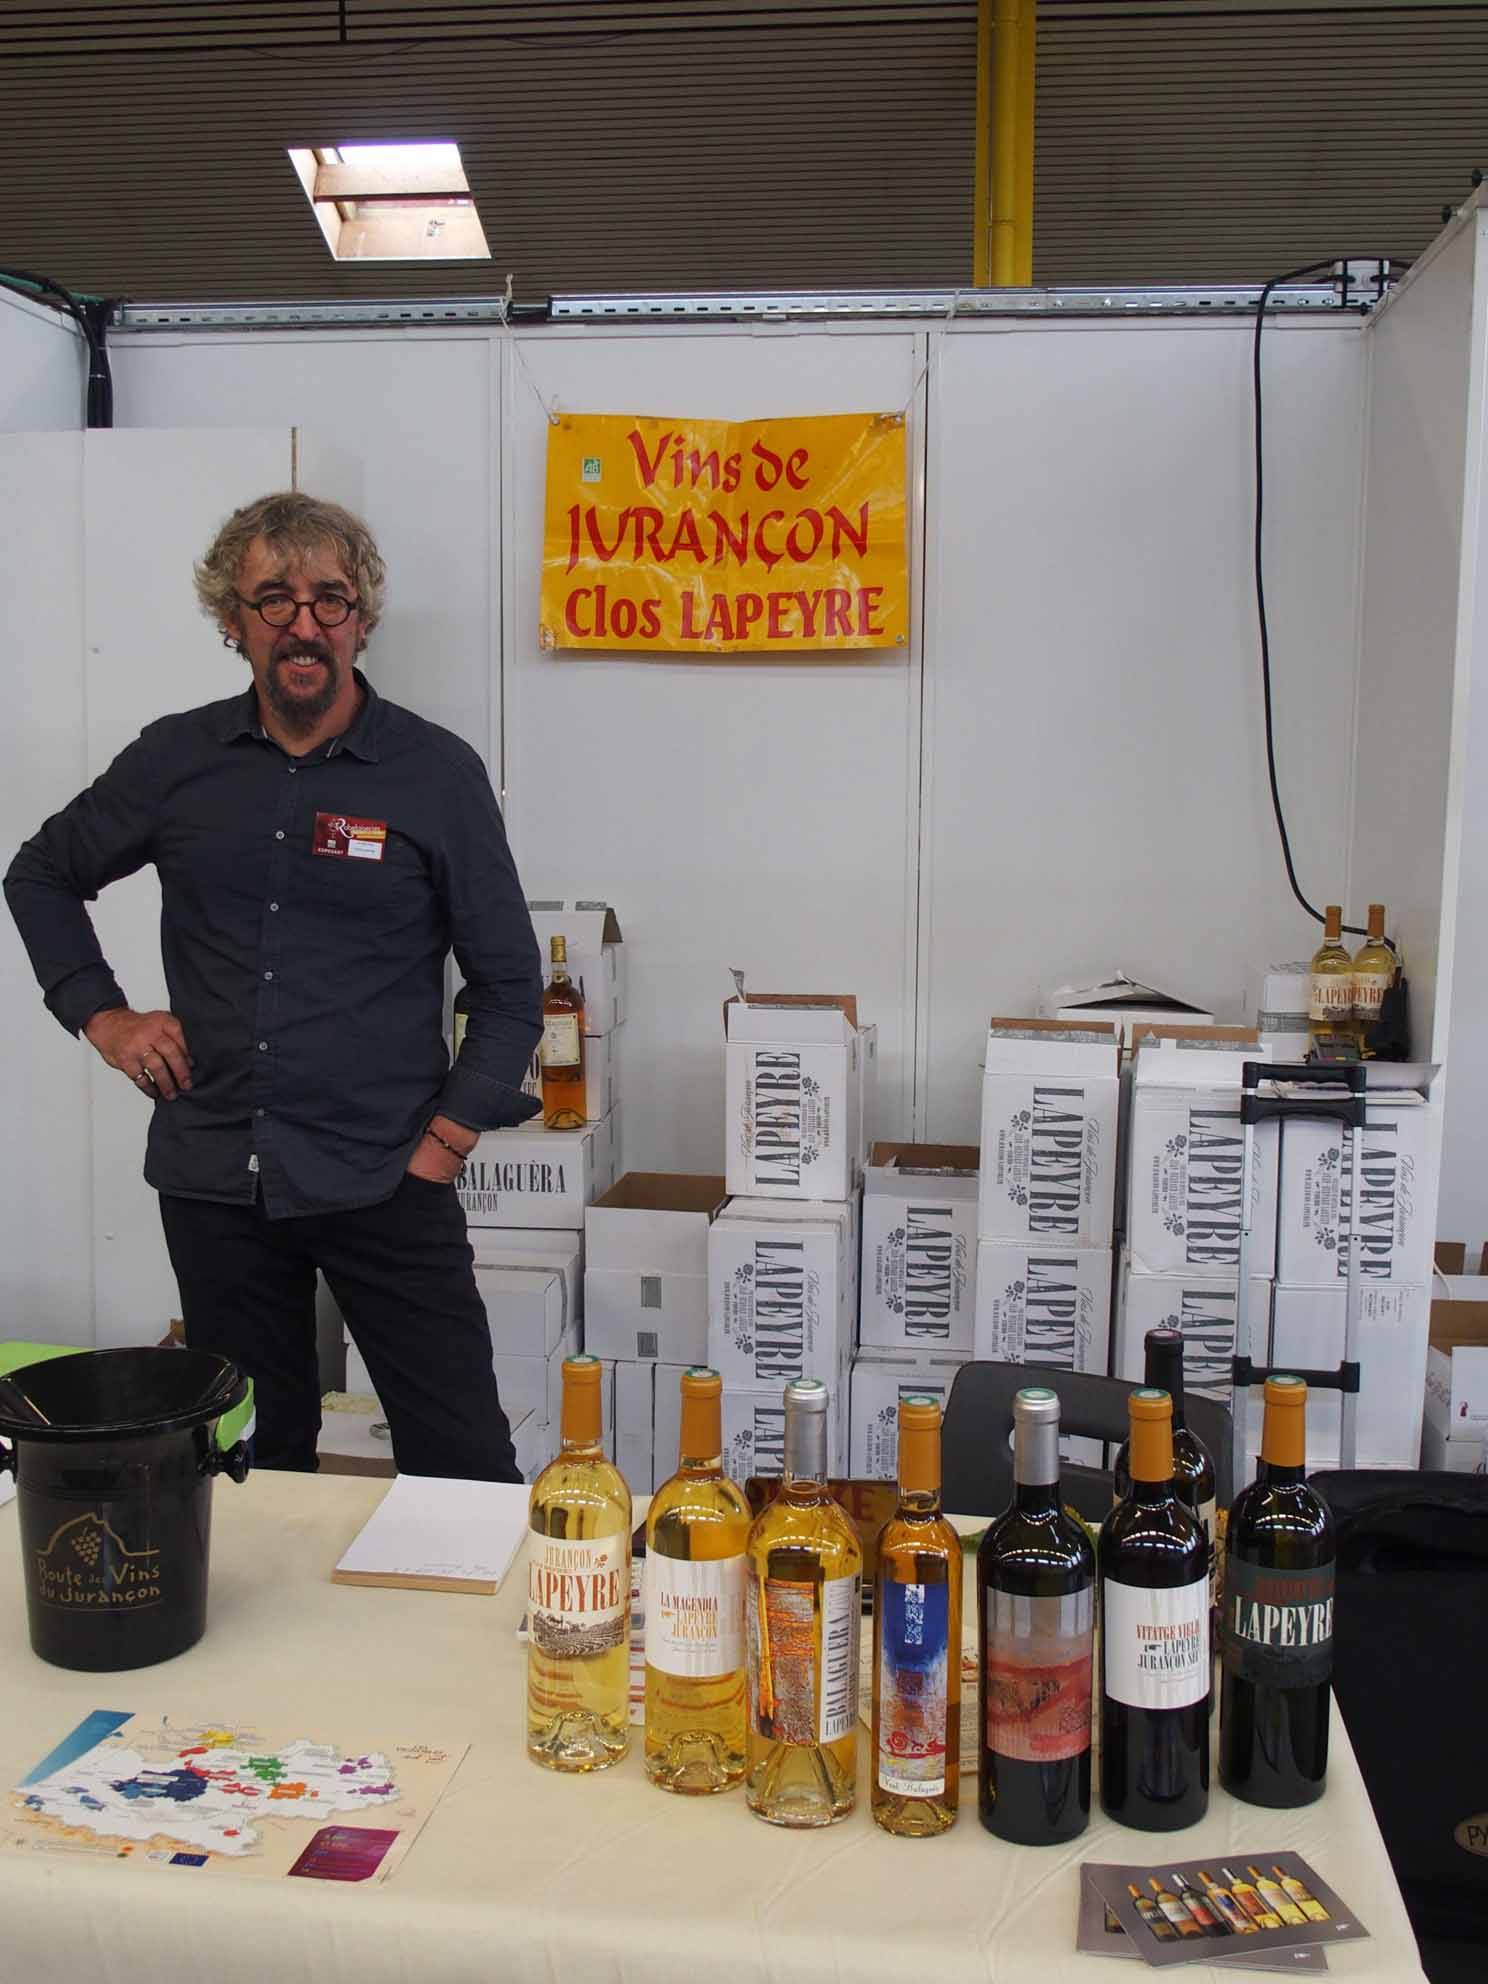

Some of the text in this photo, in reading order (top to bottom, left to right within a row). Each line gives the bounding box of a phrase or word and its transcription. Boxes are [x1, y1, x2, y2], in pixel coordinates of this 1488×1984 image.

[626, 430, 811, 494] Vins de
[565, 501, 870, 575] JURANÇON
[564, 584, 884, 642] Clos LAPEYRE
[755, 1051, 800, 1188] LAPEYRE
[457, 1159, 567, 1193] BALAGUÈRA
[1029, 1086, 1085, 1234] LAPEYRE
[1187, 1106, 1242, 1265] LAPEYRE
[458, 1191, 498, 1215] URANÇON
[1338, 1121, 1399, 1279] LAPEYRE
[905, 1205, 953, 1339] LAPEYRE
[755, 1240, 805, 1381] LAPEYRE
[1024, 1256, 1078, 1374] LAPEY
[1181, 1289, 1236, 1397] LAPEY
[37, 1556, 82, 1585] Route
[110, 1562, 161, 1585] Vins
[528, 1561, 620, 1612] LAPEYRE
[1235, 1595, 1334, 1647] LAPEYRE
[1137, 1653, 1186, 1672] JURANÇON
